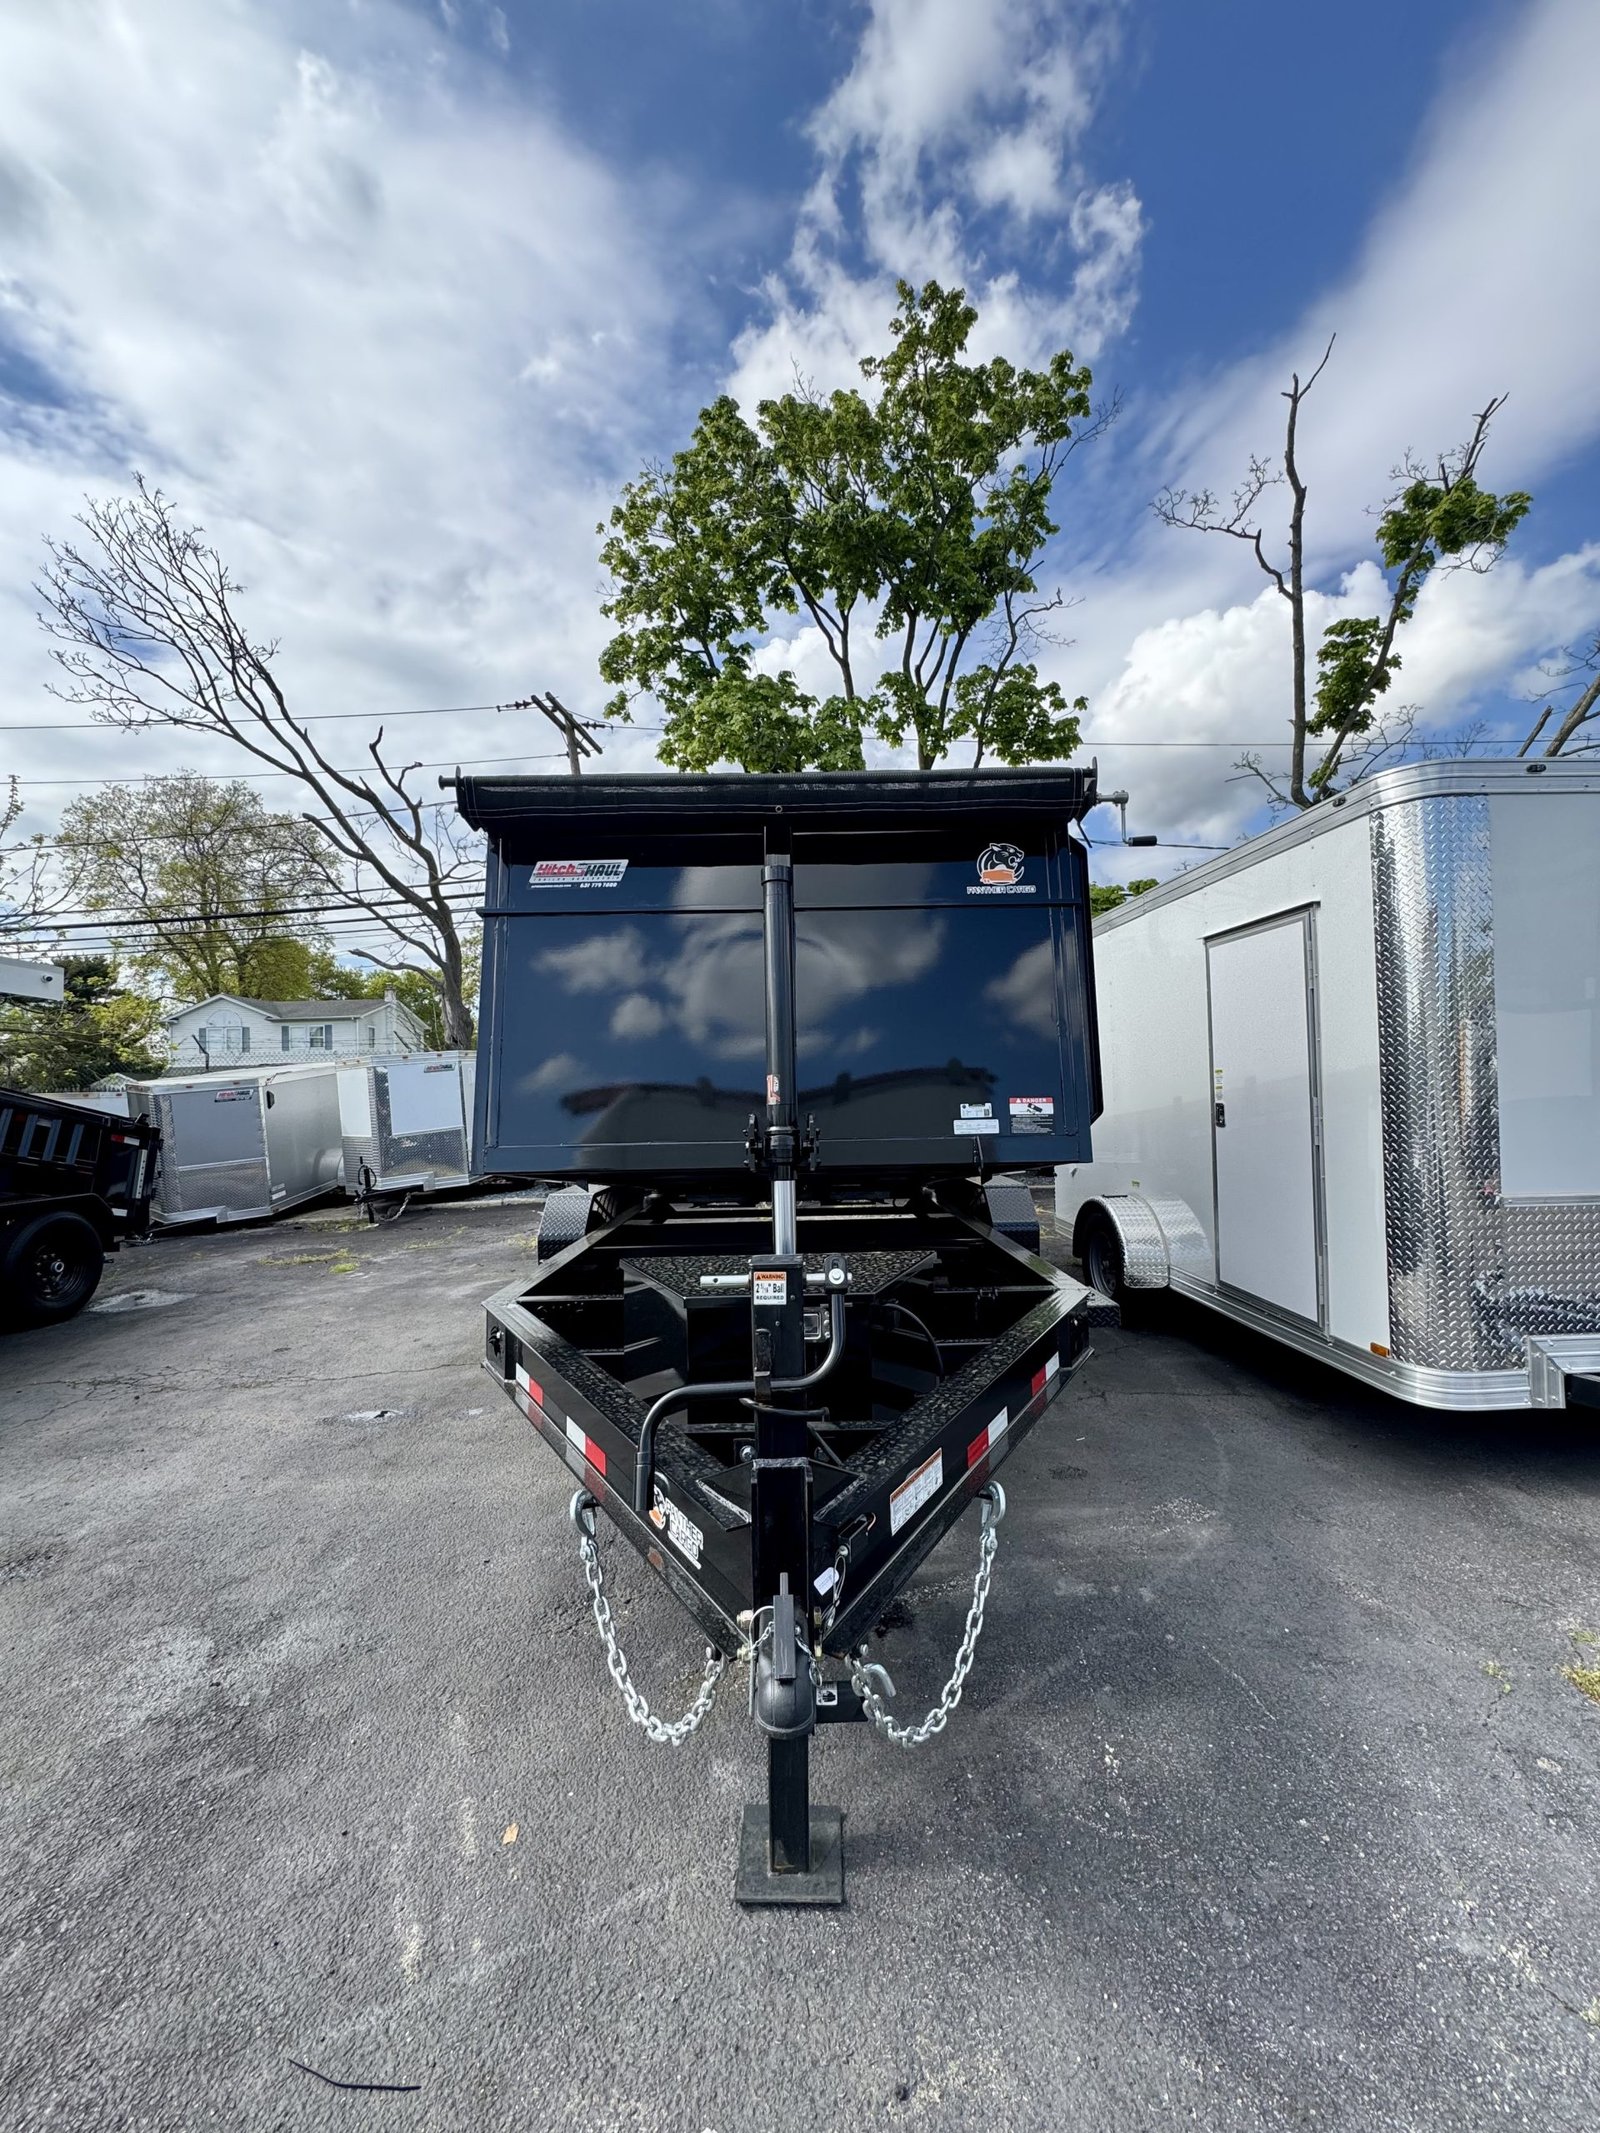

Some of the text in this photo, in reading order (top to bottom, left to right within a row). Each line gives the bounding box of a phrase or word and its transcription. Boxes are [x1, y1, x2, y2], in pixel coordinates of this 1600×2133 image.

[966, 885, 1036, 894] PANTHER CARGO
[773, 1283, 785, 1293] Ball
[665, 1497, 704, 1551] PANTHER
